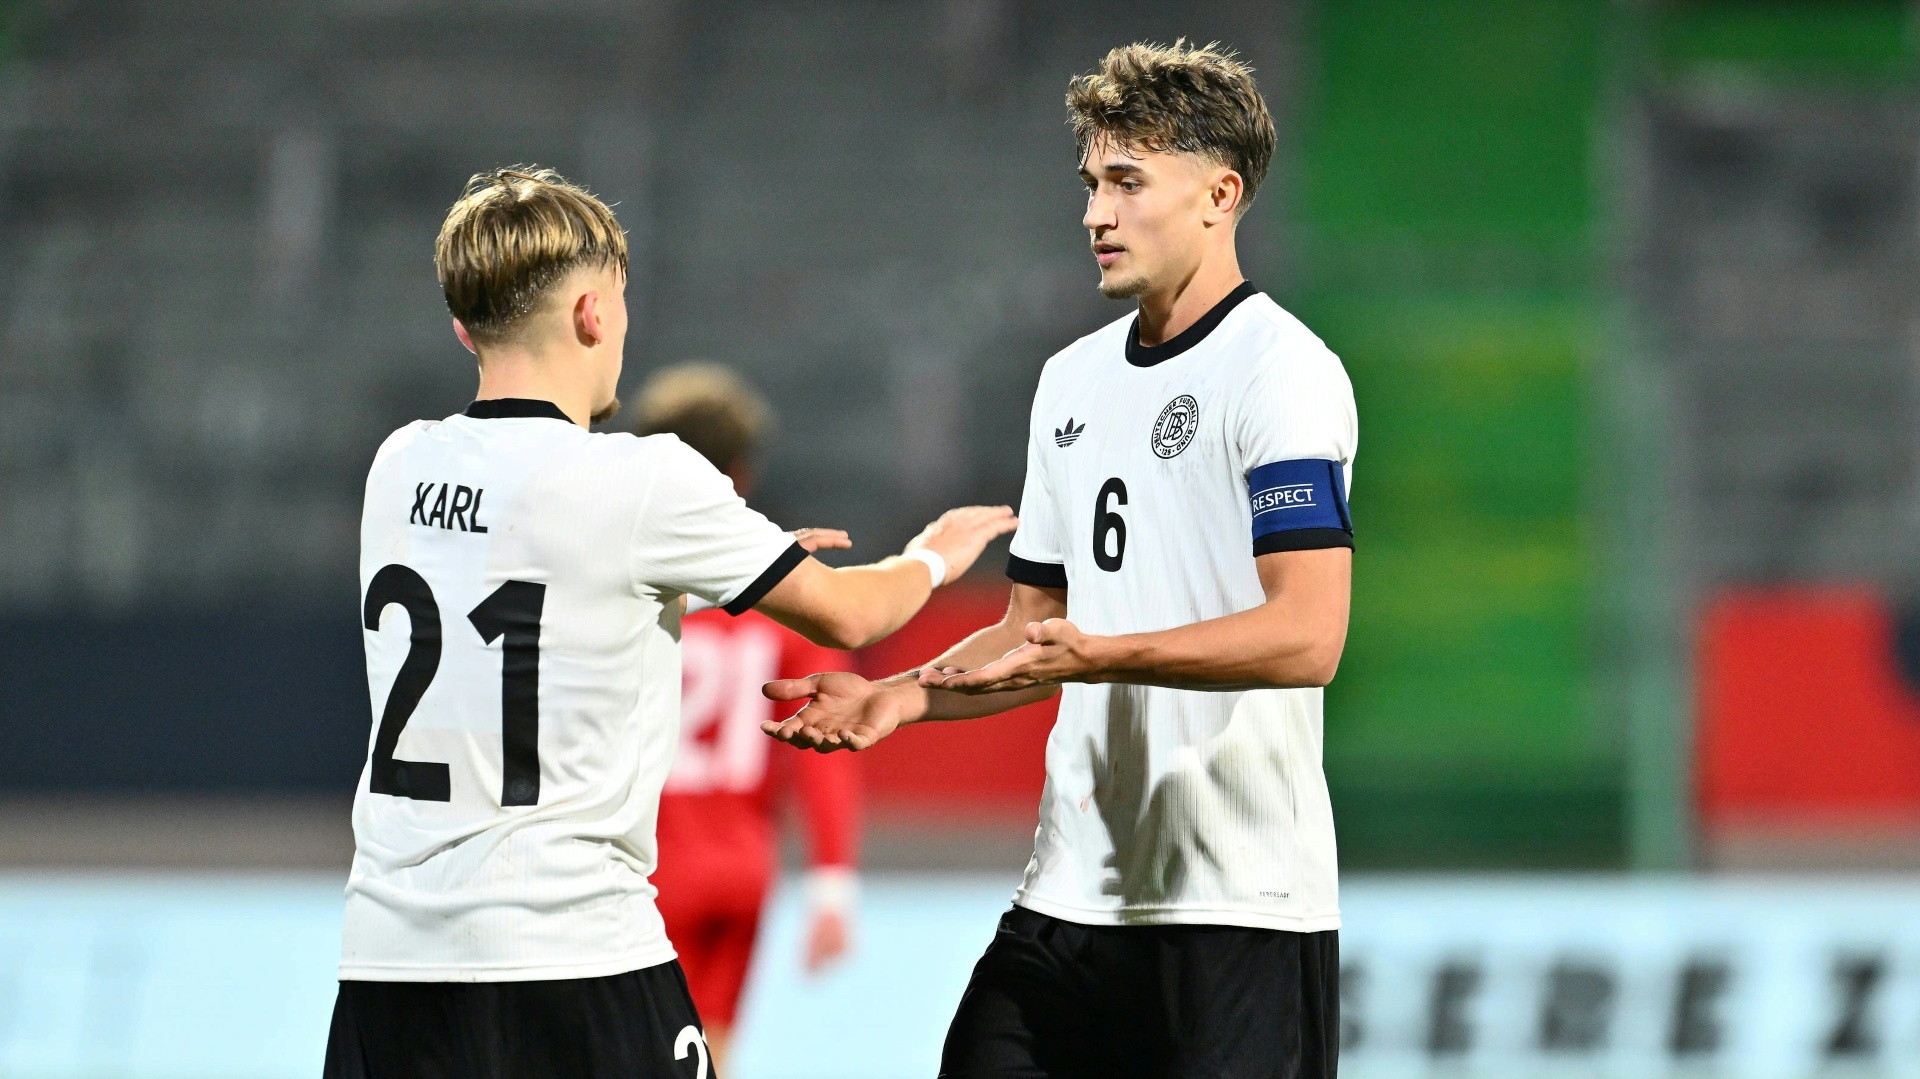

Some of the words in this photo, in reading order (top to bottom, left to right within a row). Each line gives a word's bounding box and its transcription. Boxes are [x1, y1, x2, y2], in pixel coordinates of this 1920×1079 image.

[410, 482, 489, 534] KARL
[1092, 477, 1128, 572] 6
[1251, 488, 1314, 512] RESPECT
[363, 563, 547, 807] 21
